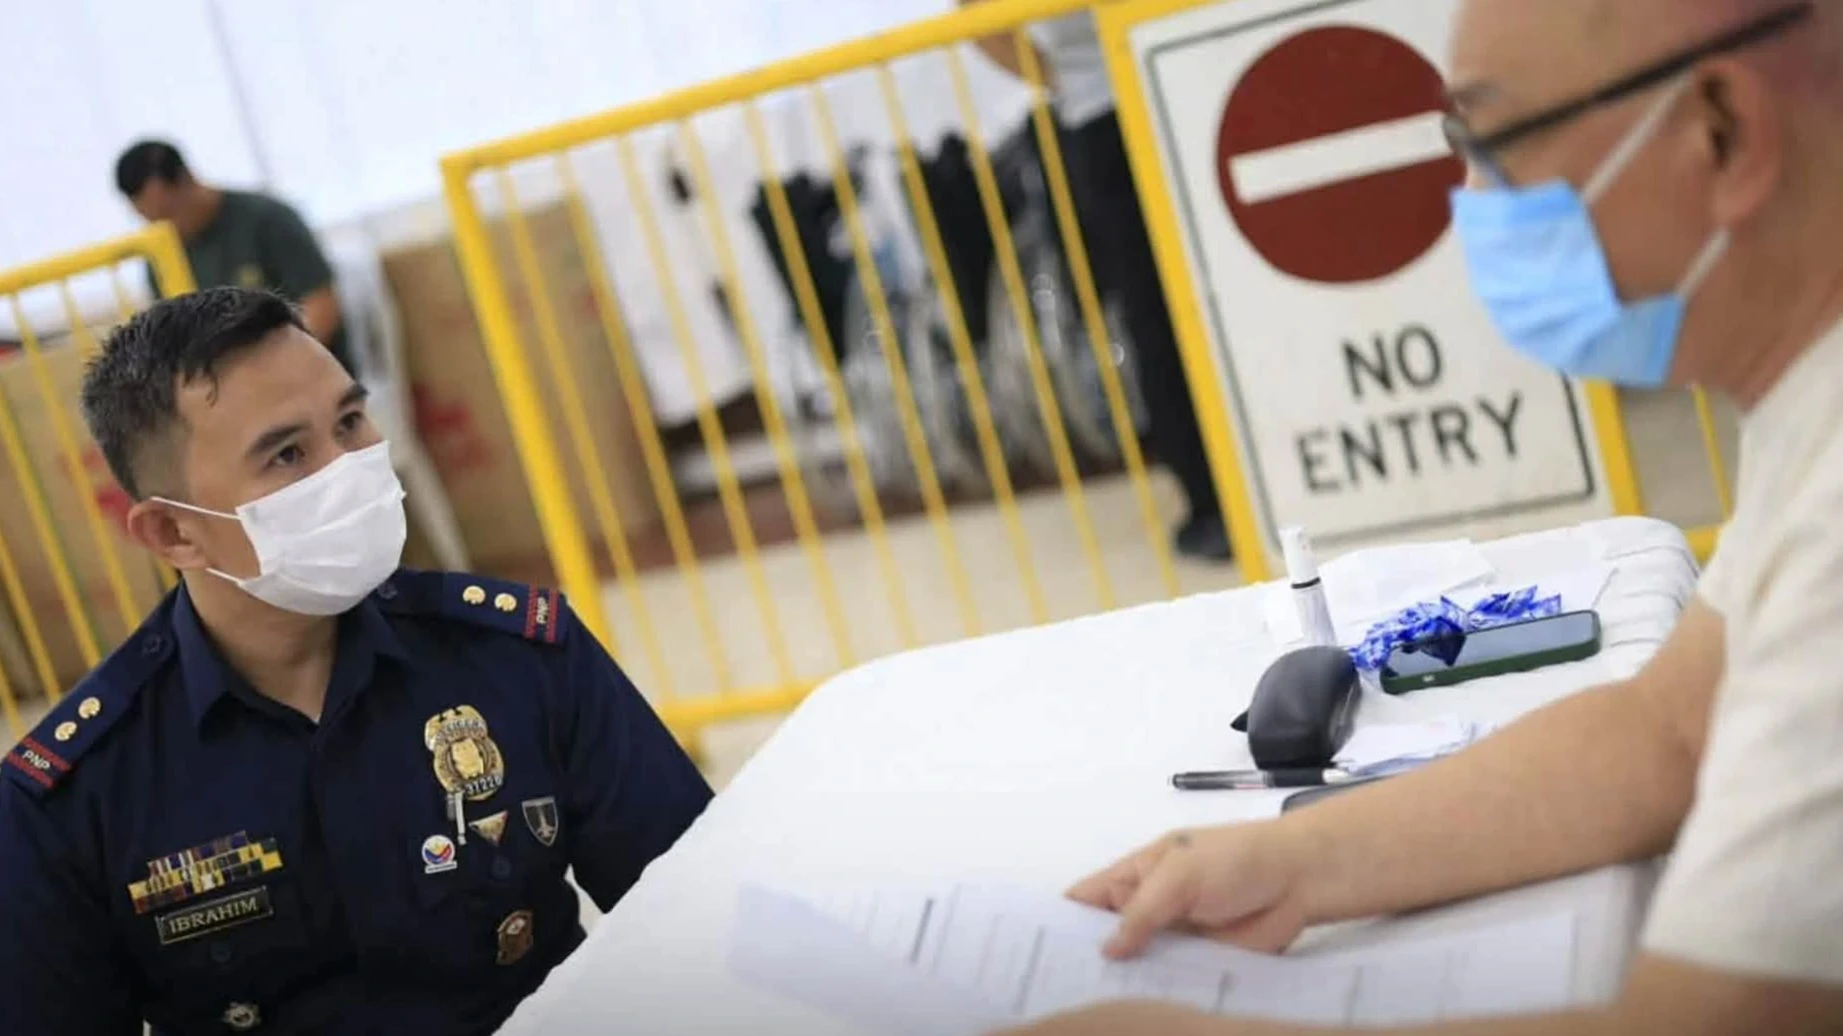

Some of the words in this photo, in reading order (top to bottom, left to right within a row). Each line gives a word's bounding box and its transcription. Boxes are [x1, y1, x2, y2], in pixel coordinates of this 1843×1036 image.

[1341, 322, 1443, 397] NO
[1295, 391, 1522, 493] ENTRY
[536, 597, 549, 624] PNP
[22, 750, 51, 770] PNP
[168, 896, 258, 934] IBRAHIM
